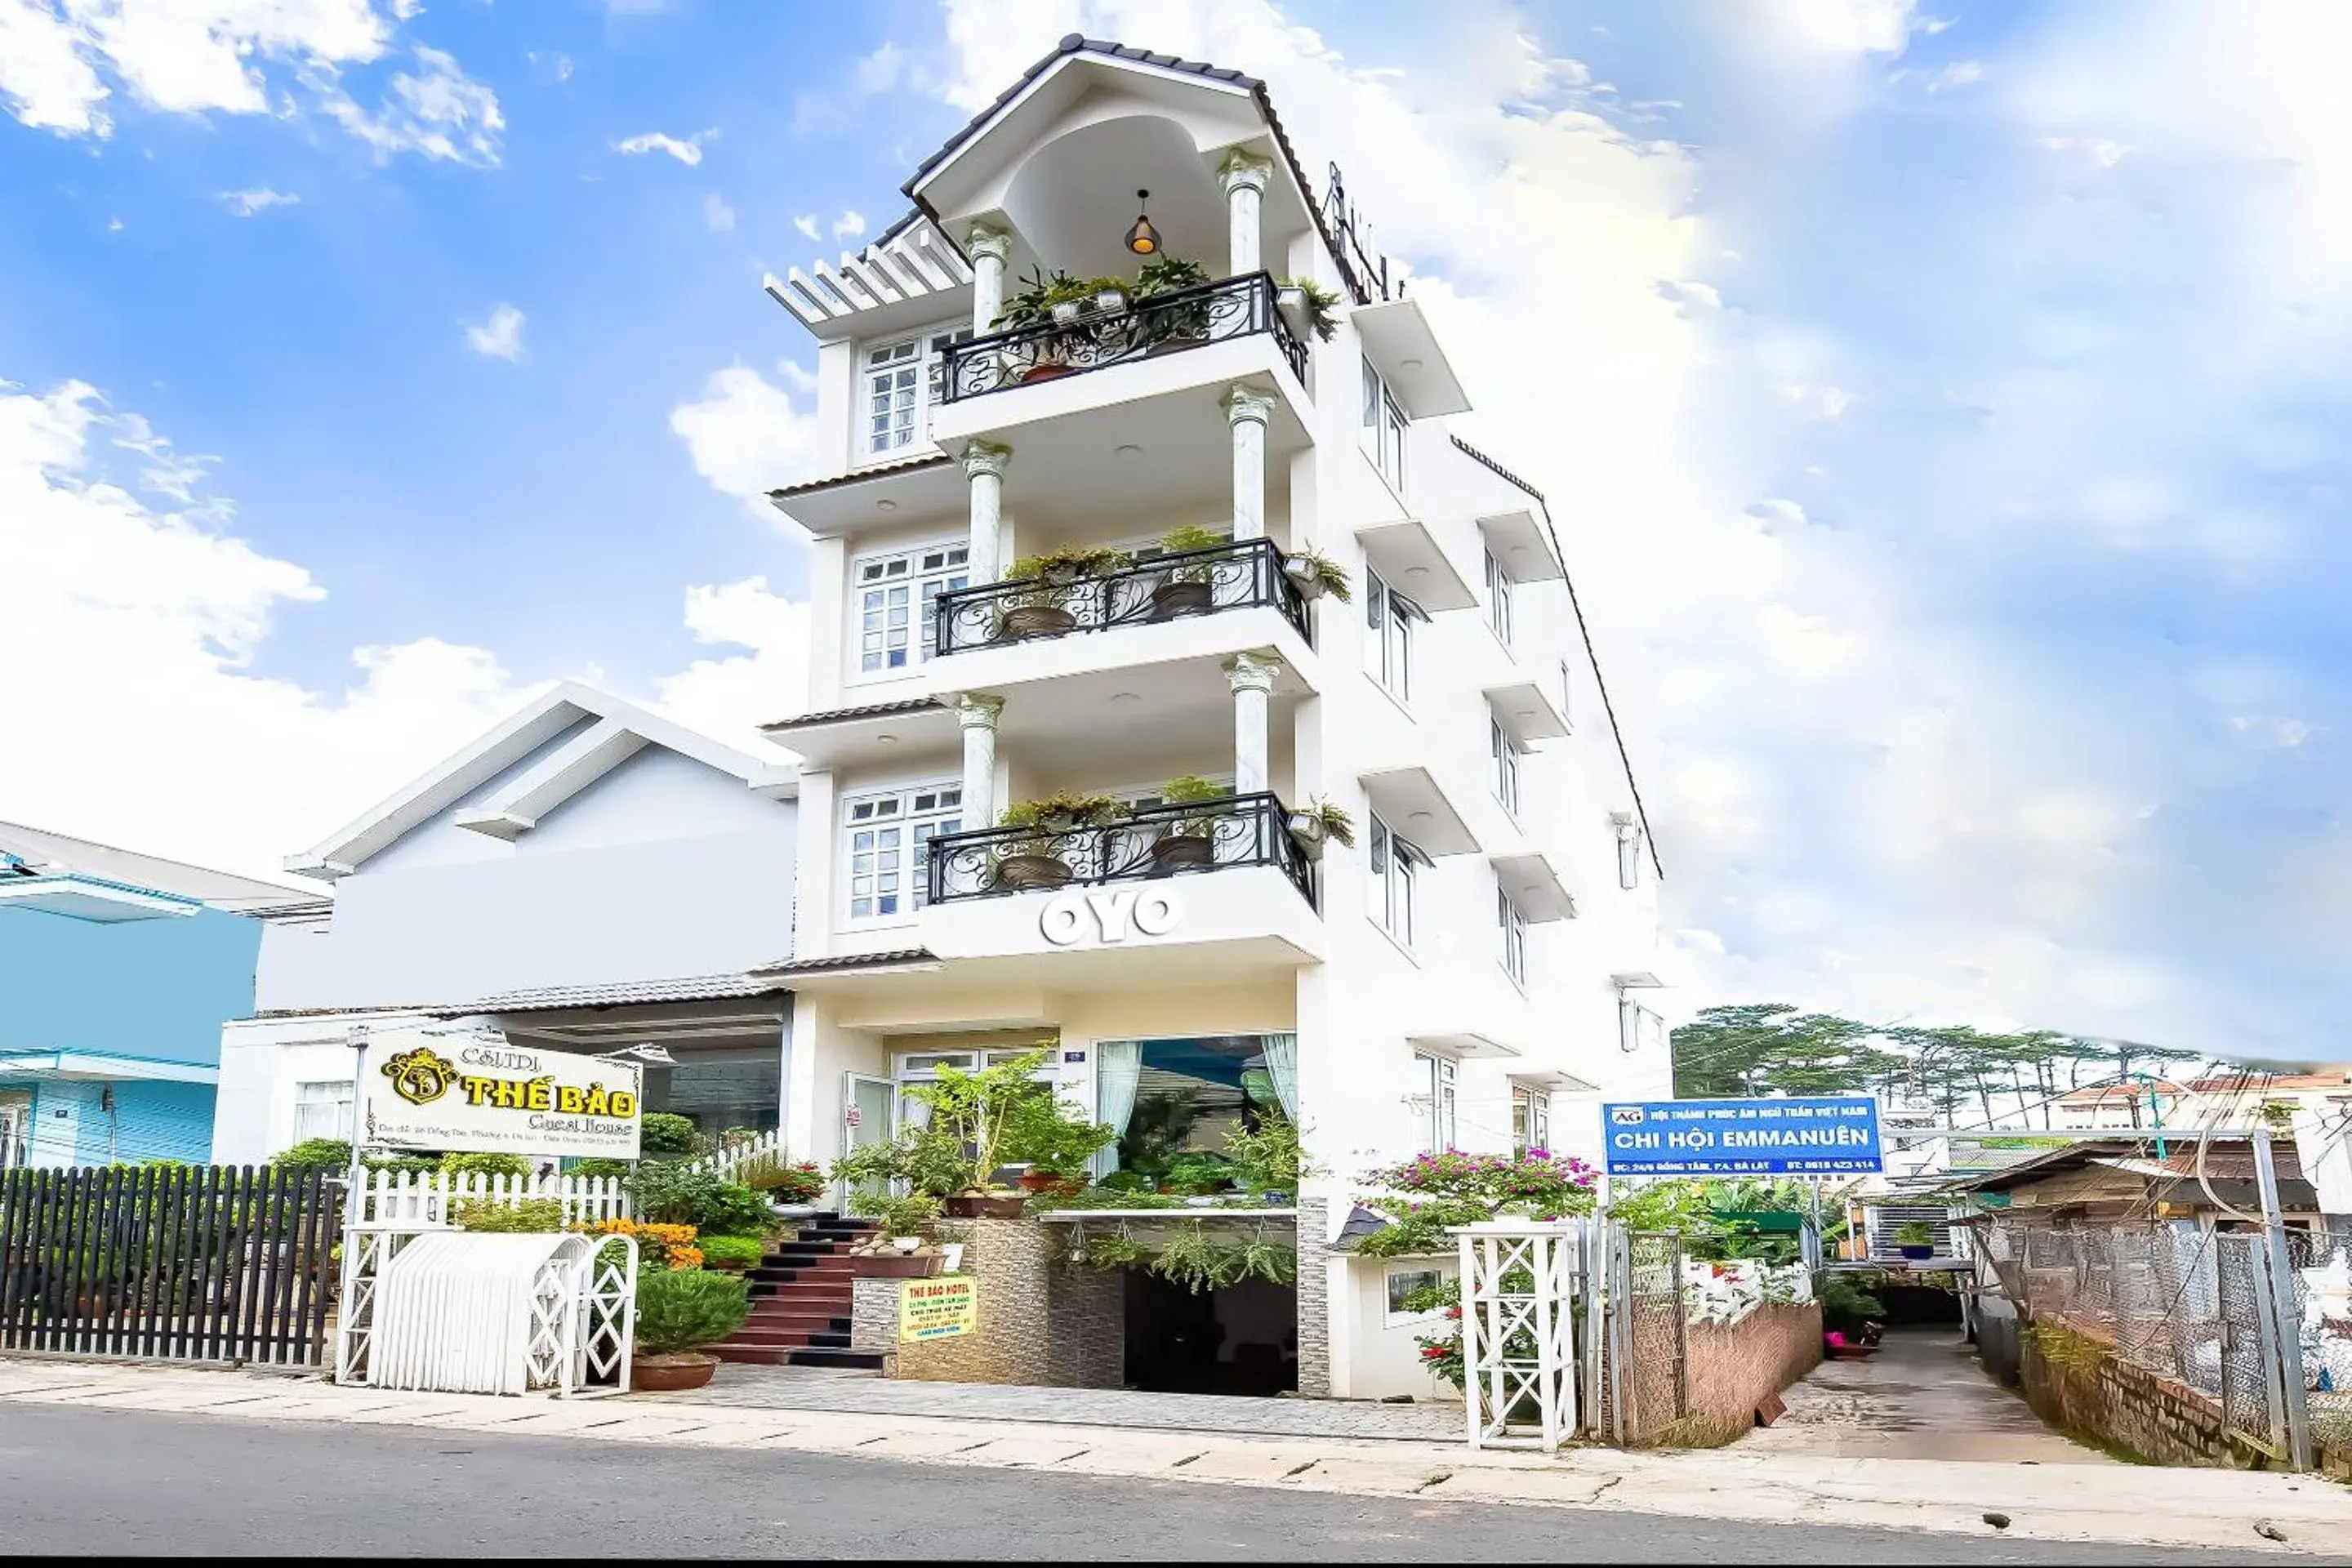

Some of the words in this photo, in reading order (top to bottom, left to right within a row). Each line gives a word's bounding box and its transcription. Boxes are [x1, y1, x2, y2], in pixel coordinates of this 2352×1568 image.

[1040, 887, 1182, 946] OYO
[462, 1075, 555, 1111] THẾ
[555, 1081, 636, 1119] BẢO
[528, 1113, 581, 1132] Guest
[581, 1118, 633, 1136] House
[1614, 1131, 1659, 1149] CHI
[1668, 1127, 1714, 1152] HỘI
[1722, 1126, 1869, 1148] EMMANUÊN
[947, 1283, 970, 1294] HOTEL
